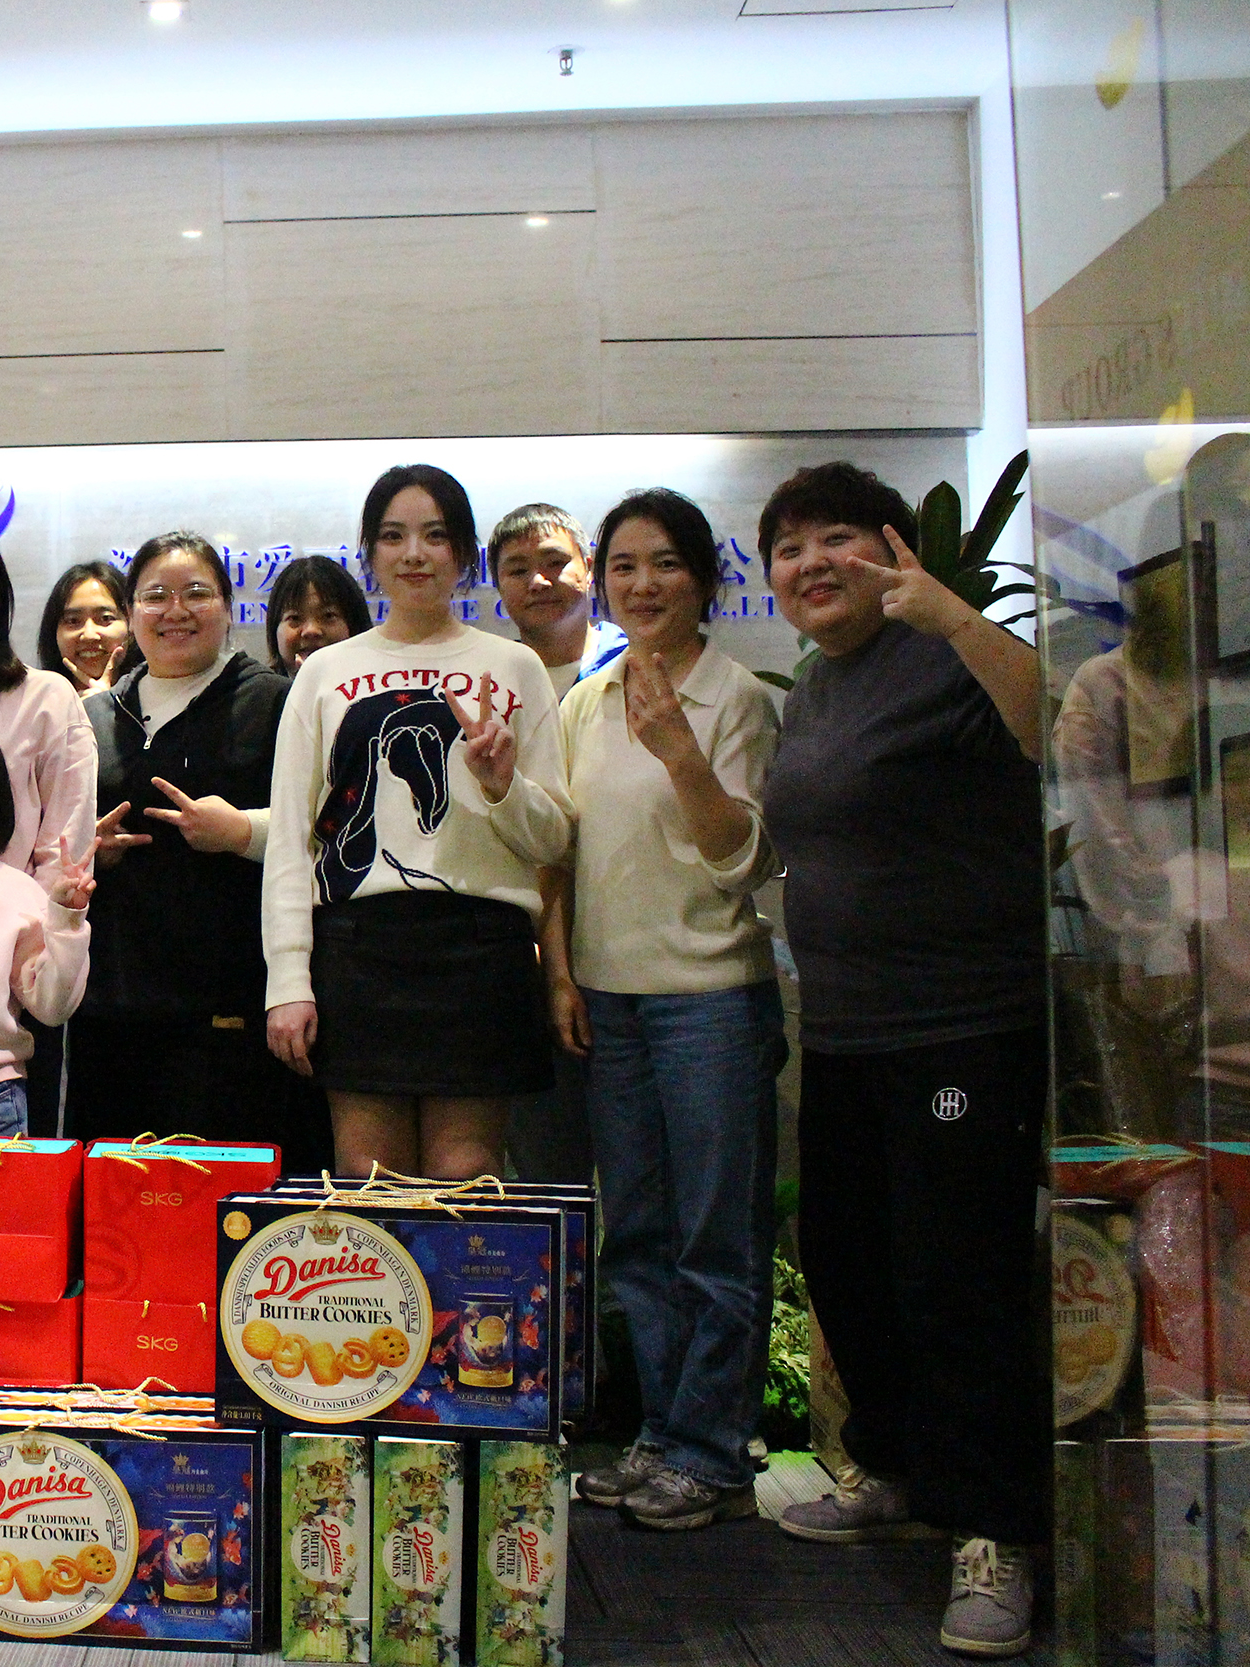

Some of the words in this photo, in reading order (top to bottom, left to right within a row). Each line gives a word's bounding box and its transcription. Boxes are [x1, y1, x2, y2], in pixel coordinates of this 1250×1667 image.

[335, 669, 523, 725] VICTORY
[140, 1191, 182, 1207] SKG
[254, 1246, 386, 1303] Danisa
[357, 1232, 407, 1278] COPENHAGEN
[402, 1278, 419, 1324] DENMARK
[260, 1302, 320, 1321] BUTTER
[323, 1305, 392, 1325] COOKIES
[318, 1295, 385, 1307] TRADITIONAL
[136, 1335, 179, 1351] SKG
[269, 1381, 312, 1406] ORIGINAL
[313, 1400, 348, 1409] DANISH
[349, 1387, 381, 1406] RECIPE
[64, 1453, 111, 1497] COPENHAGEN
[109, 1497, 125, 1541] DENMARK
[27, 1514, 92, 1526] TRADITIONAL
[31, 1524, 99, 1542] COOKIES
[301, 1528, 310, 1570] COOKIES
[310, 1531, 320, 1567] BUTTER
[321, 1519, 346, 1576] Danisa
[392, 1535, 402, 1578] COOKIES
[402, 1538, 413, 1576] BUTTER
[413, 1526, 439, 1585] Danisa
[496, 1534, 507, 1577] COOKIES
[506, 1537, 517, 1575] BUTTER
[518, 1526, 543, 1586] Danisa
[23, 1616, 57, 1624] DANISH
[59, 1603, 89, 1621] RECIPE
